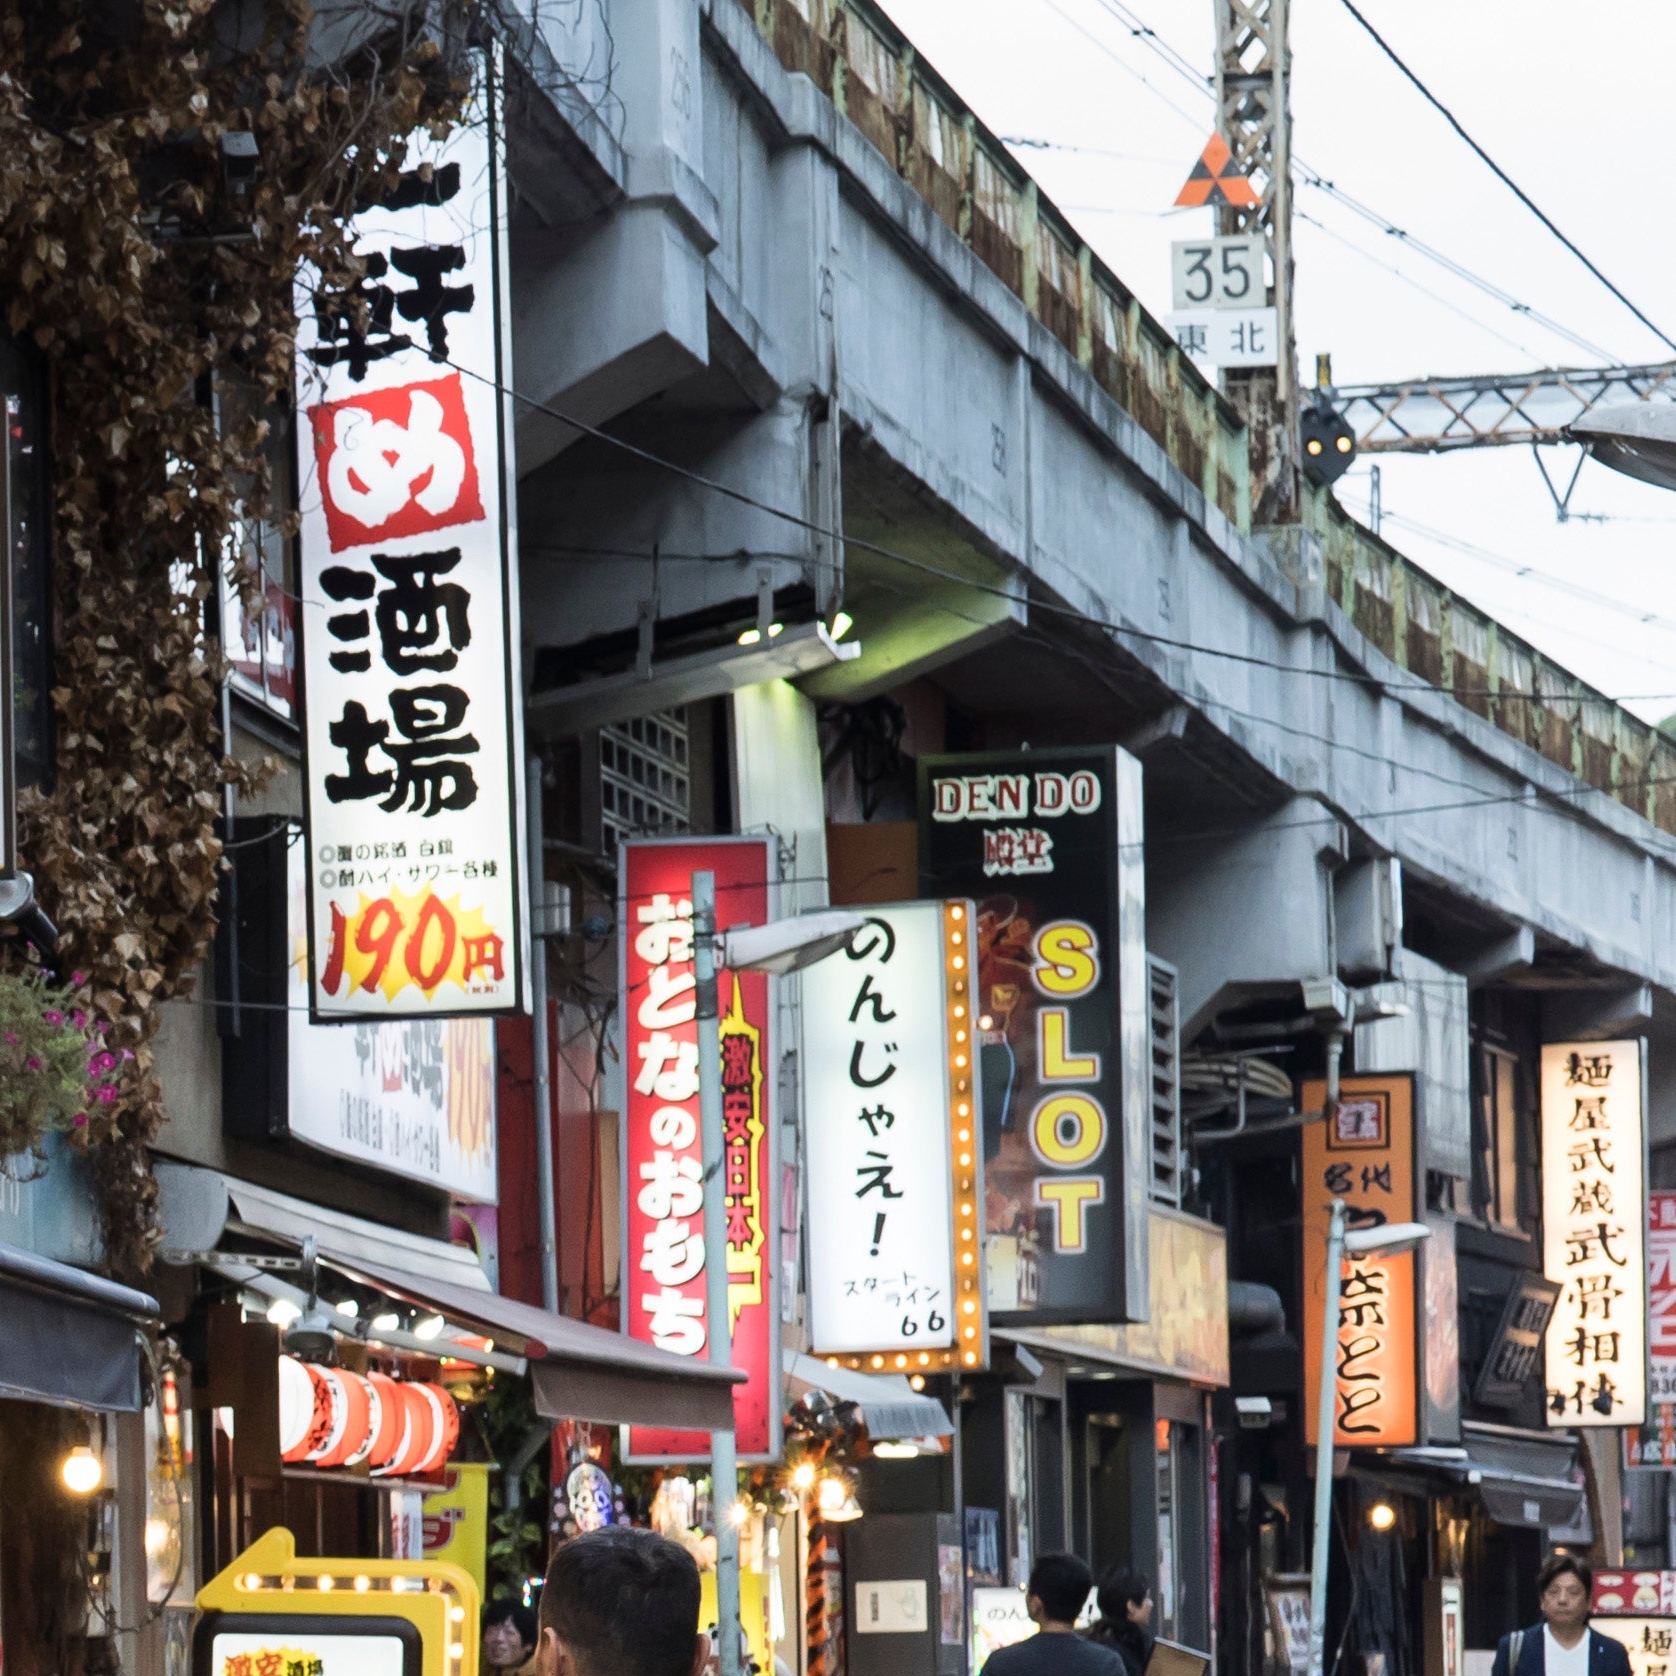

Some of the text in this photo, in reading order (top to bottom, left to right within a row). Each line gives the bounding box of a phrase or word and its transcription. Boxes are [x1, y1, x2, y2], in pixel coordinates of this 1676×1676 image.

[1183, 246, 1251, 303] 35
[1176, 320, 1265, 355] 東北
[320, 893, 505, 996] 190円
[1032, 920, 1107, 1255] SLOT
[843, 1271, 917, 1296] スタート
[886, 1286, 940, 1308] ライン
